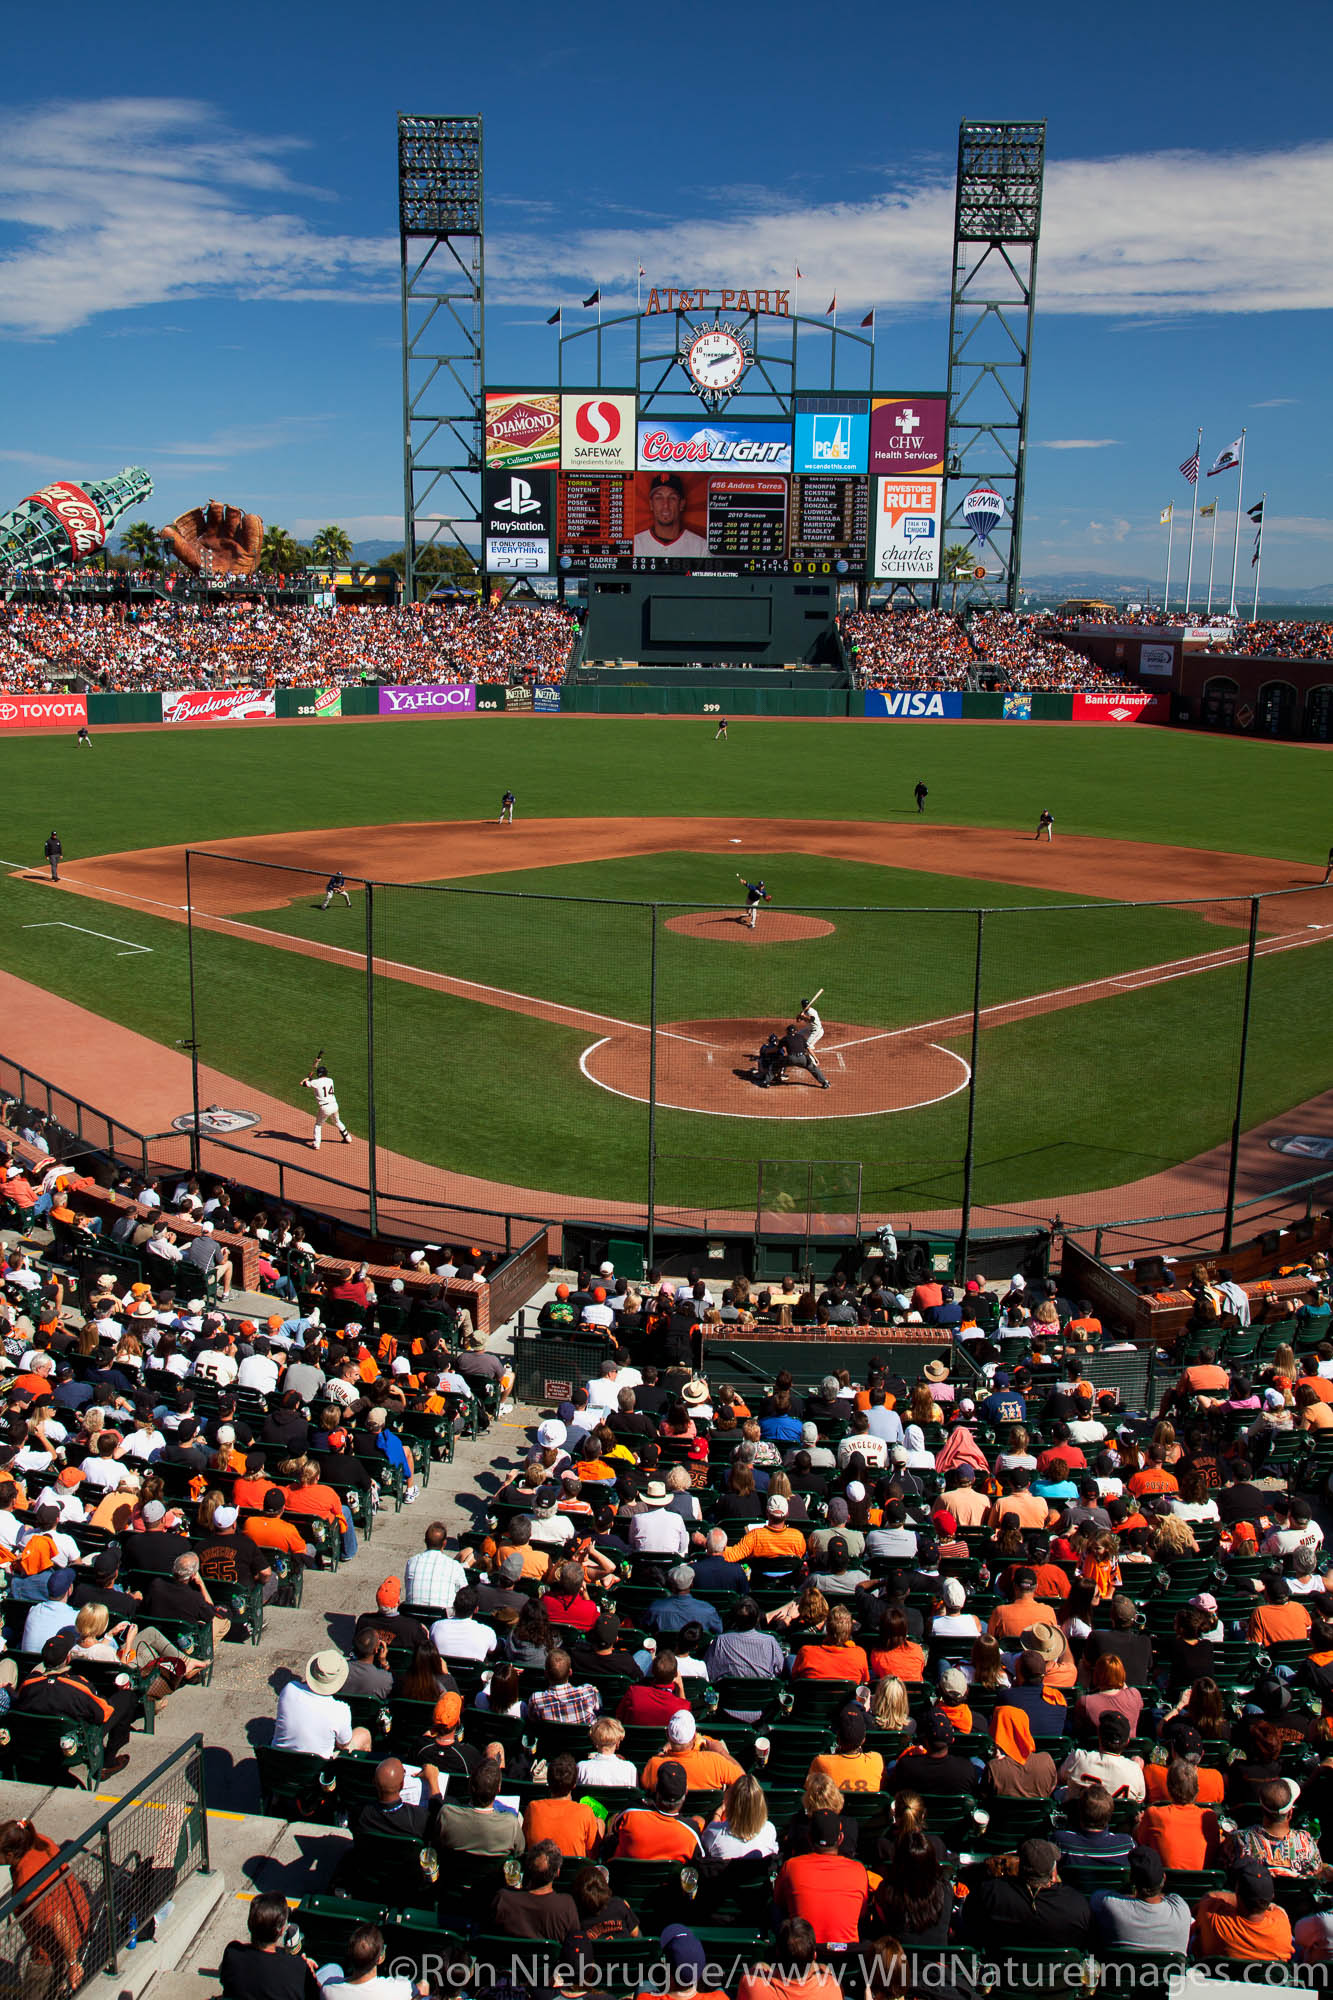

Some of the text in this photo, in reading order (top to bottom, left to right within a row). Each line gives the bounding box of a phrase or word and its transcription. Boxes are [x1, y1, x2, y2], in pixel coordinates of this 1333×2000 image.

[646, 288, 789, 316] AT&T PARK
[678, 320, 754, 366] SAN FRANCISCO
[690, 382, 742, 401] GIANTS
[492, 414, 554, 437] DIAMOND
[642, 431, 787, 462] Coors LIGHT
[889, 436, 925, 448] CHW
[575, 448, 621, 457] SAFEWAY
[815, 441, 848, 457] PG&E
[904, 451, 937, 460] Services
[886, 494, 932, 508] RULE
[968, 496, 1000, 509] RE/MAX
[491, 521, 544, 533] PlayStation
[882, 545, 933, 560] charles
[497, 558, 538, 568] PS3
[794, 563, 830, 573] 0 0 0
[881, 562, 933, 572] SCHWAB
[315, 688, 341, 709] EMERALD
[384, 688, 469, 711] YAHOO!
[880, 692, 944, 716] VISA
[1085, 695, 1158, 705] Bank of America
[20, 704, 85, 717] TOYOTA
[164, 690, 261, 721] Budweiser
[298, 706, 316, 714] 382
[322, 1085, 334, 1097] 14
[194, 1363, 218, 1379] 55
[844, 1442, 883, 1453] LINCECUM
[1300, 1534, 1315, 1546] MAYS
[839, 1780, 868, 1792] 48
